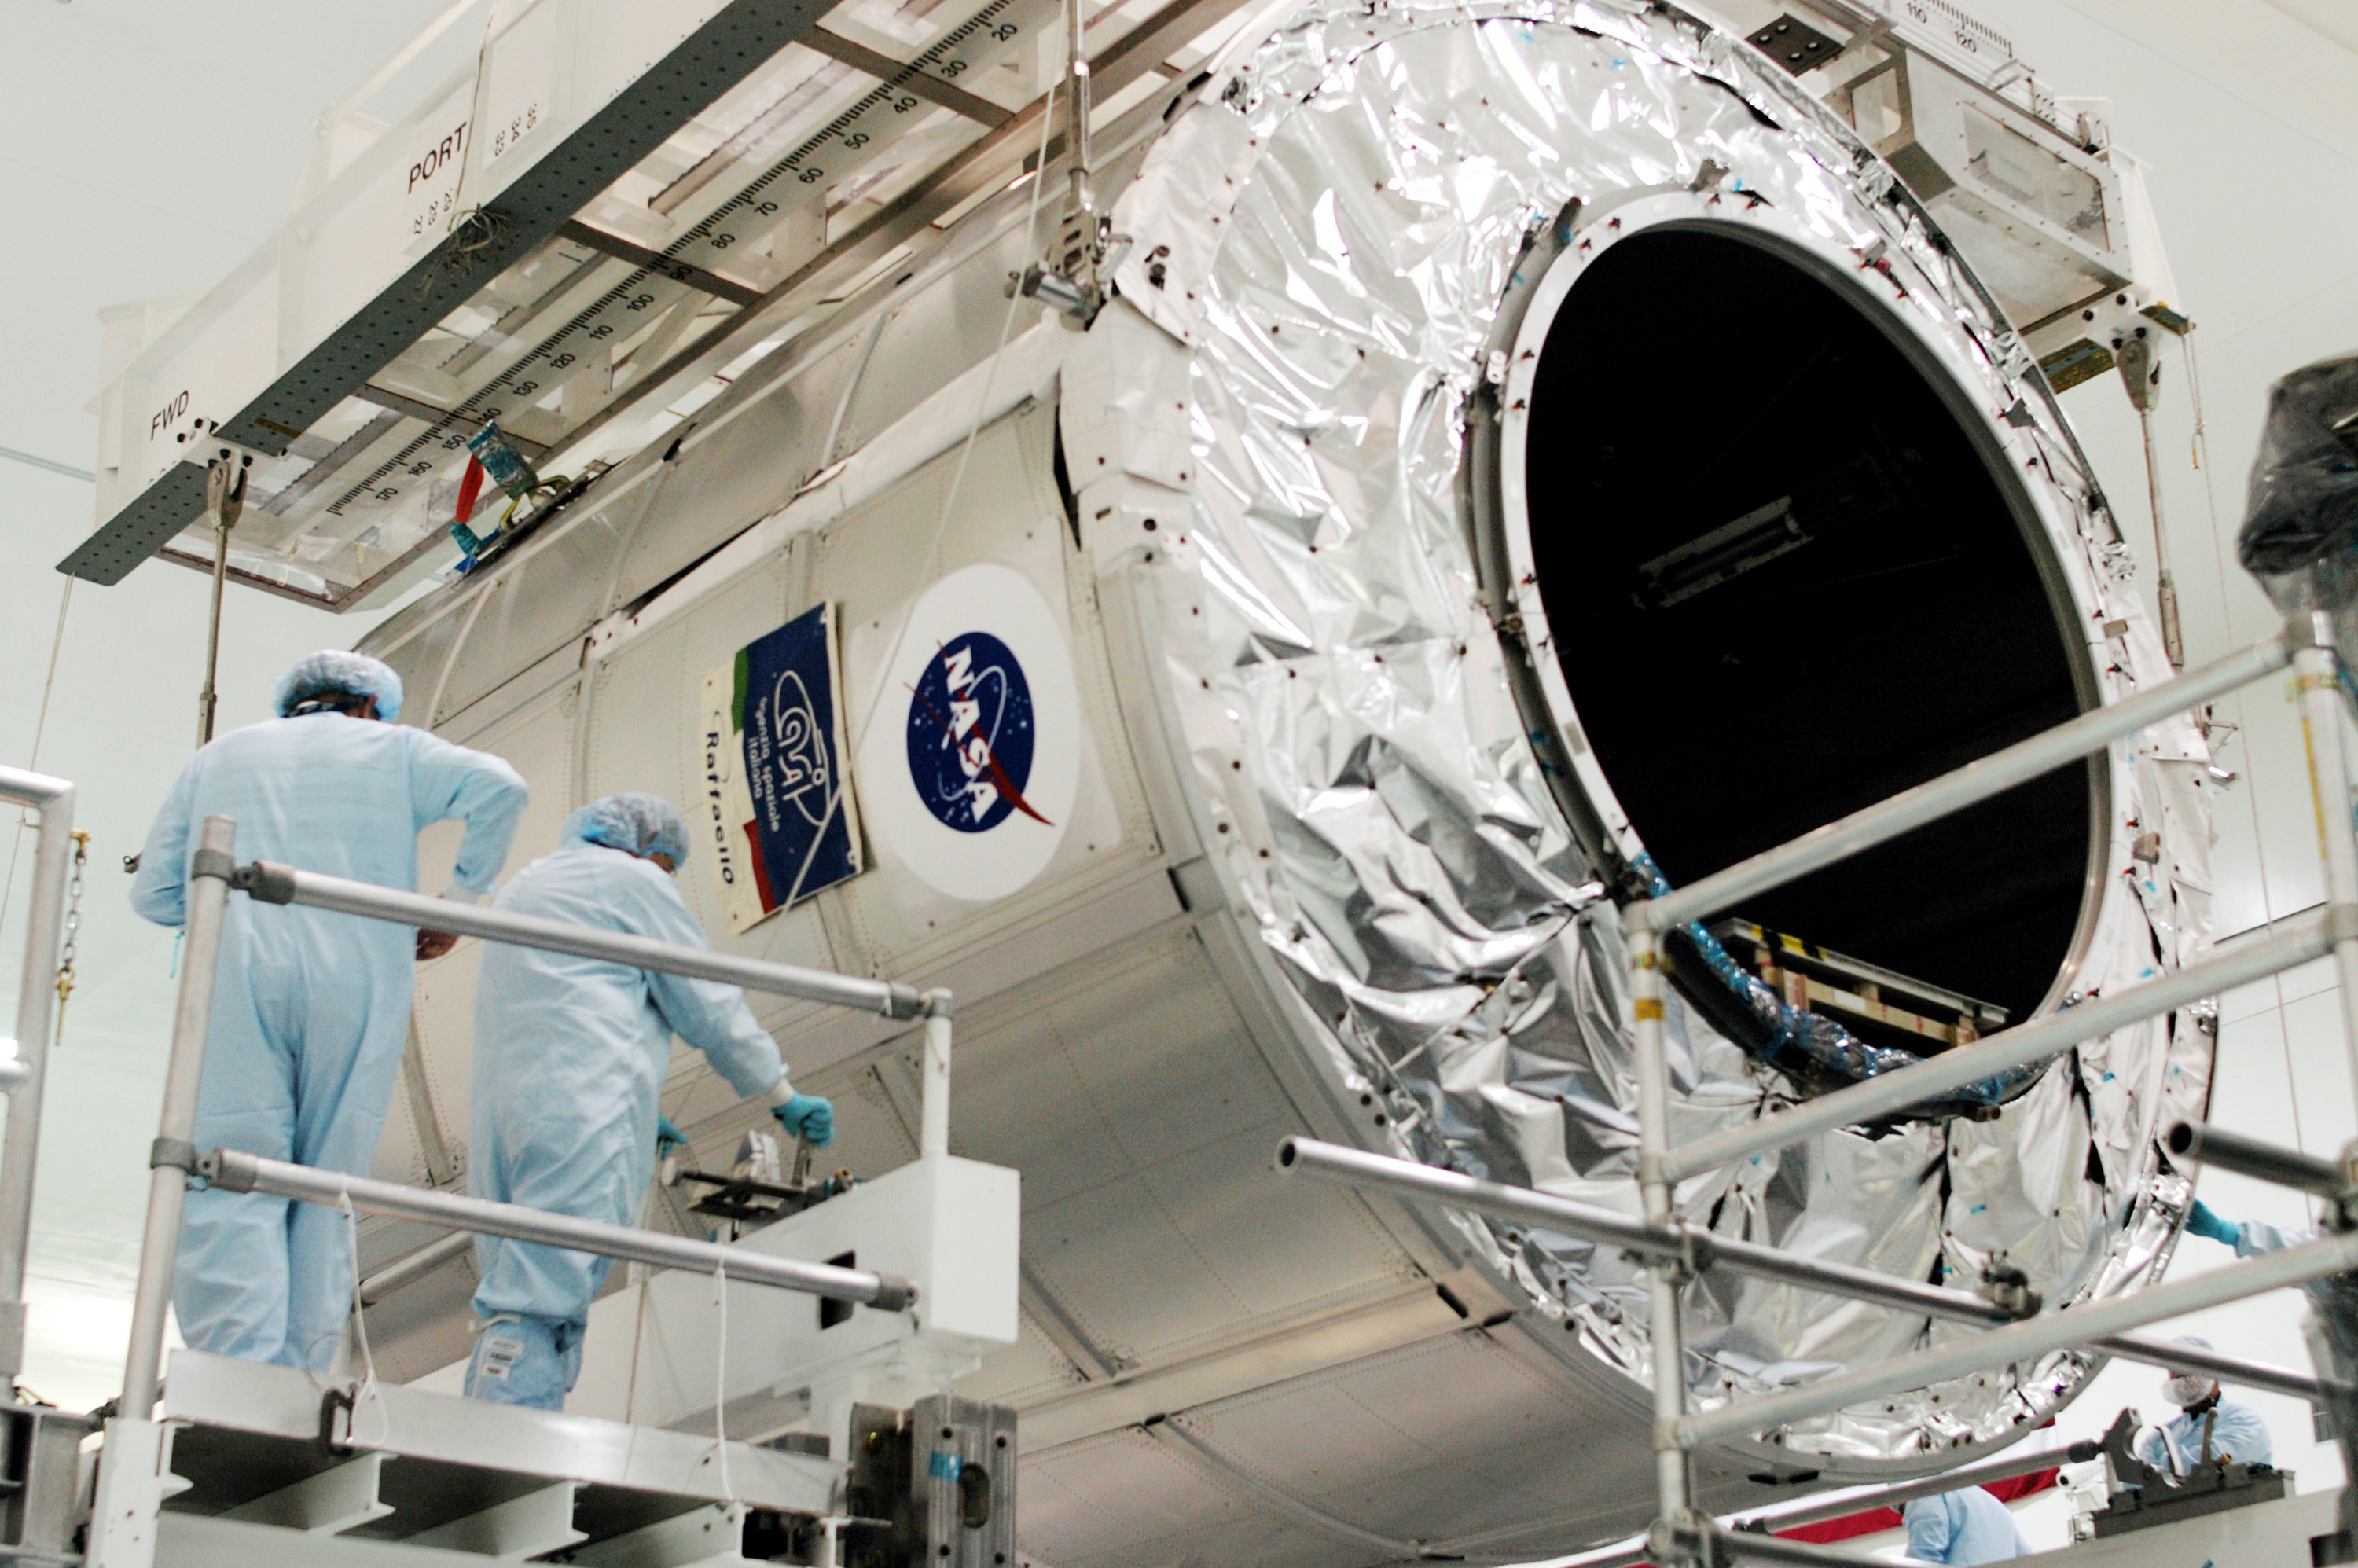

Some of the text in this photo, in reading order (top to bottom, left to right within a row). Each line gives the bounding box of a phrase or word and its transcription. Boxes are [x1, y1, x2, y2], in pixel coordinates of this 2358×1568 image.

[1907, 2, 1927, 24] 110
[991, 23, 1018, 42] 20
[1955, 30, 1977, 53] 120
[941, 60, 968, 79] 30
[893, 96, 918, 115] 40
[844, 132, 870, 150] 50
[408, 121, 468, 194] PORT
[799, 167, 824, 184] 60
[754, 201, 778, 217] 70
[711, 233, 736, 249] 80
[669, 266, 693, 281] 90
[627, 293, 656, 312] 100
[590, 324, 614, 341] 110
[550, 353, 576, 369] 120
[512, 380, 539, 397] 130
[150, 390, 189, 441] FWD
[477, 407, 503, 426] 140
[442, 435, 467, 450] 150
[407, 461, 432, 477] 160
[376, 487, 399, 501] 170
[944, 644, 999, 824] NASA
[748, 736, 763, 799] italiana
[755, 696, 782, 832] agenzia spaziale
[707, 732, 734, 884] Raffaello
